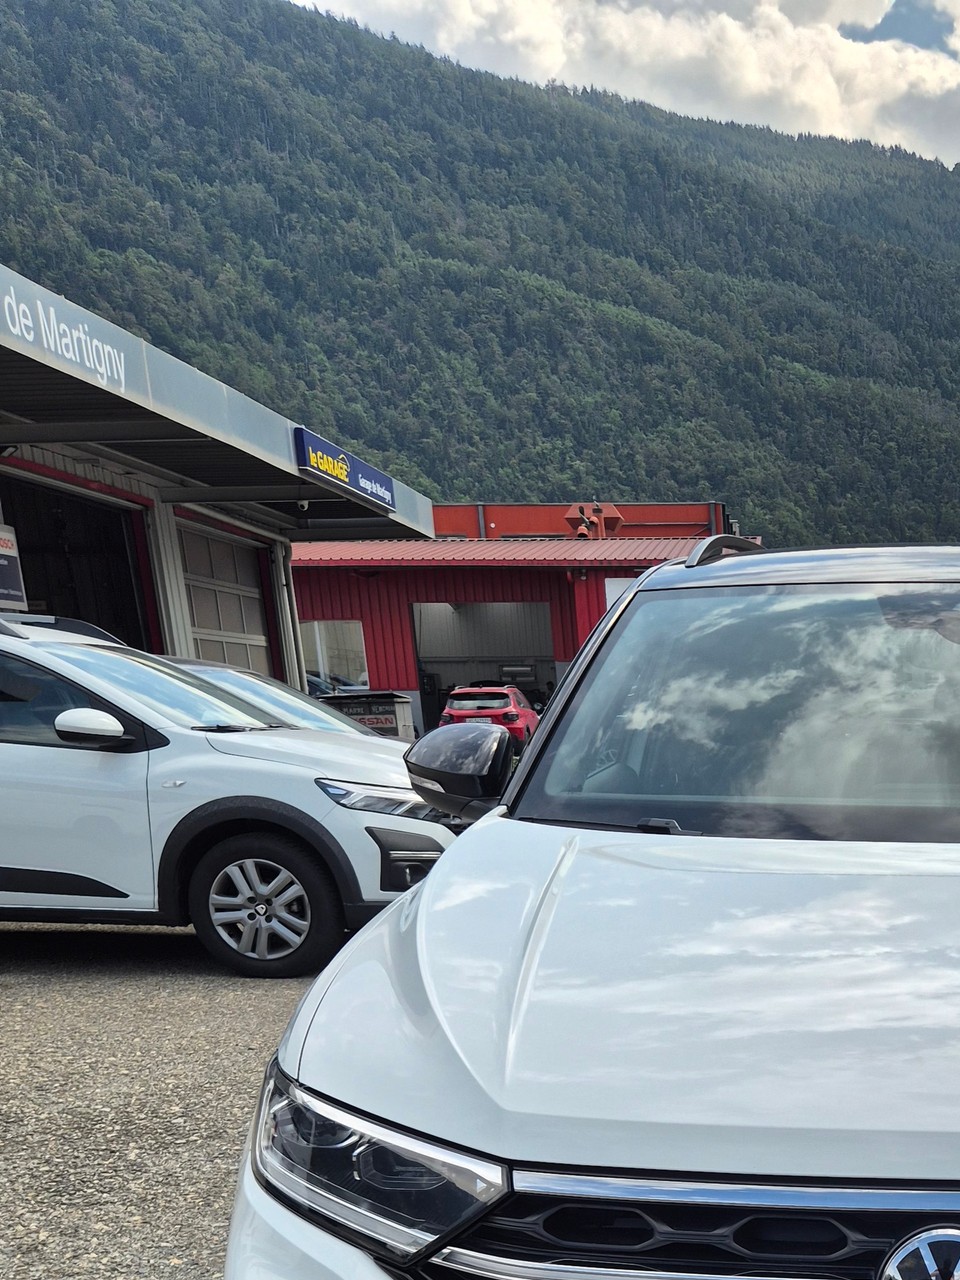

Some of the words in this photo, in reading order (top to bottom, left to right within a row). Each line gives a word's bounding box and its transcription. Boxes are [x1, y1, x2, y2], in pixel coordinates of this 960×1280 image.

[4, 285, 34, 342] de
[37, 299, 125, 394] Martigny
[317, 450, 349, 483] GARAGE
[358, 716, 395, 726] SSAN
